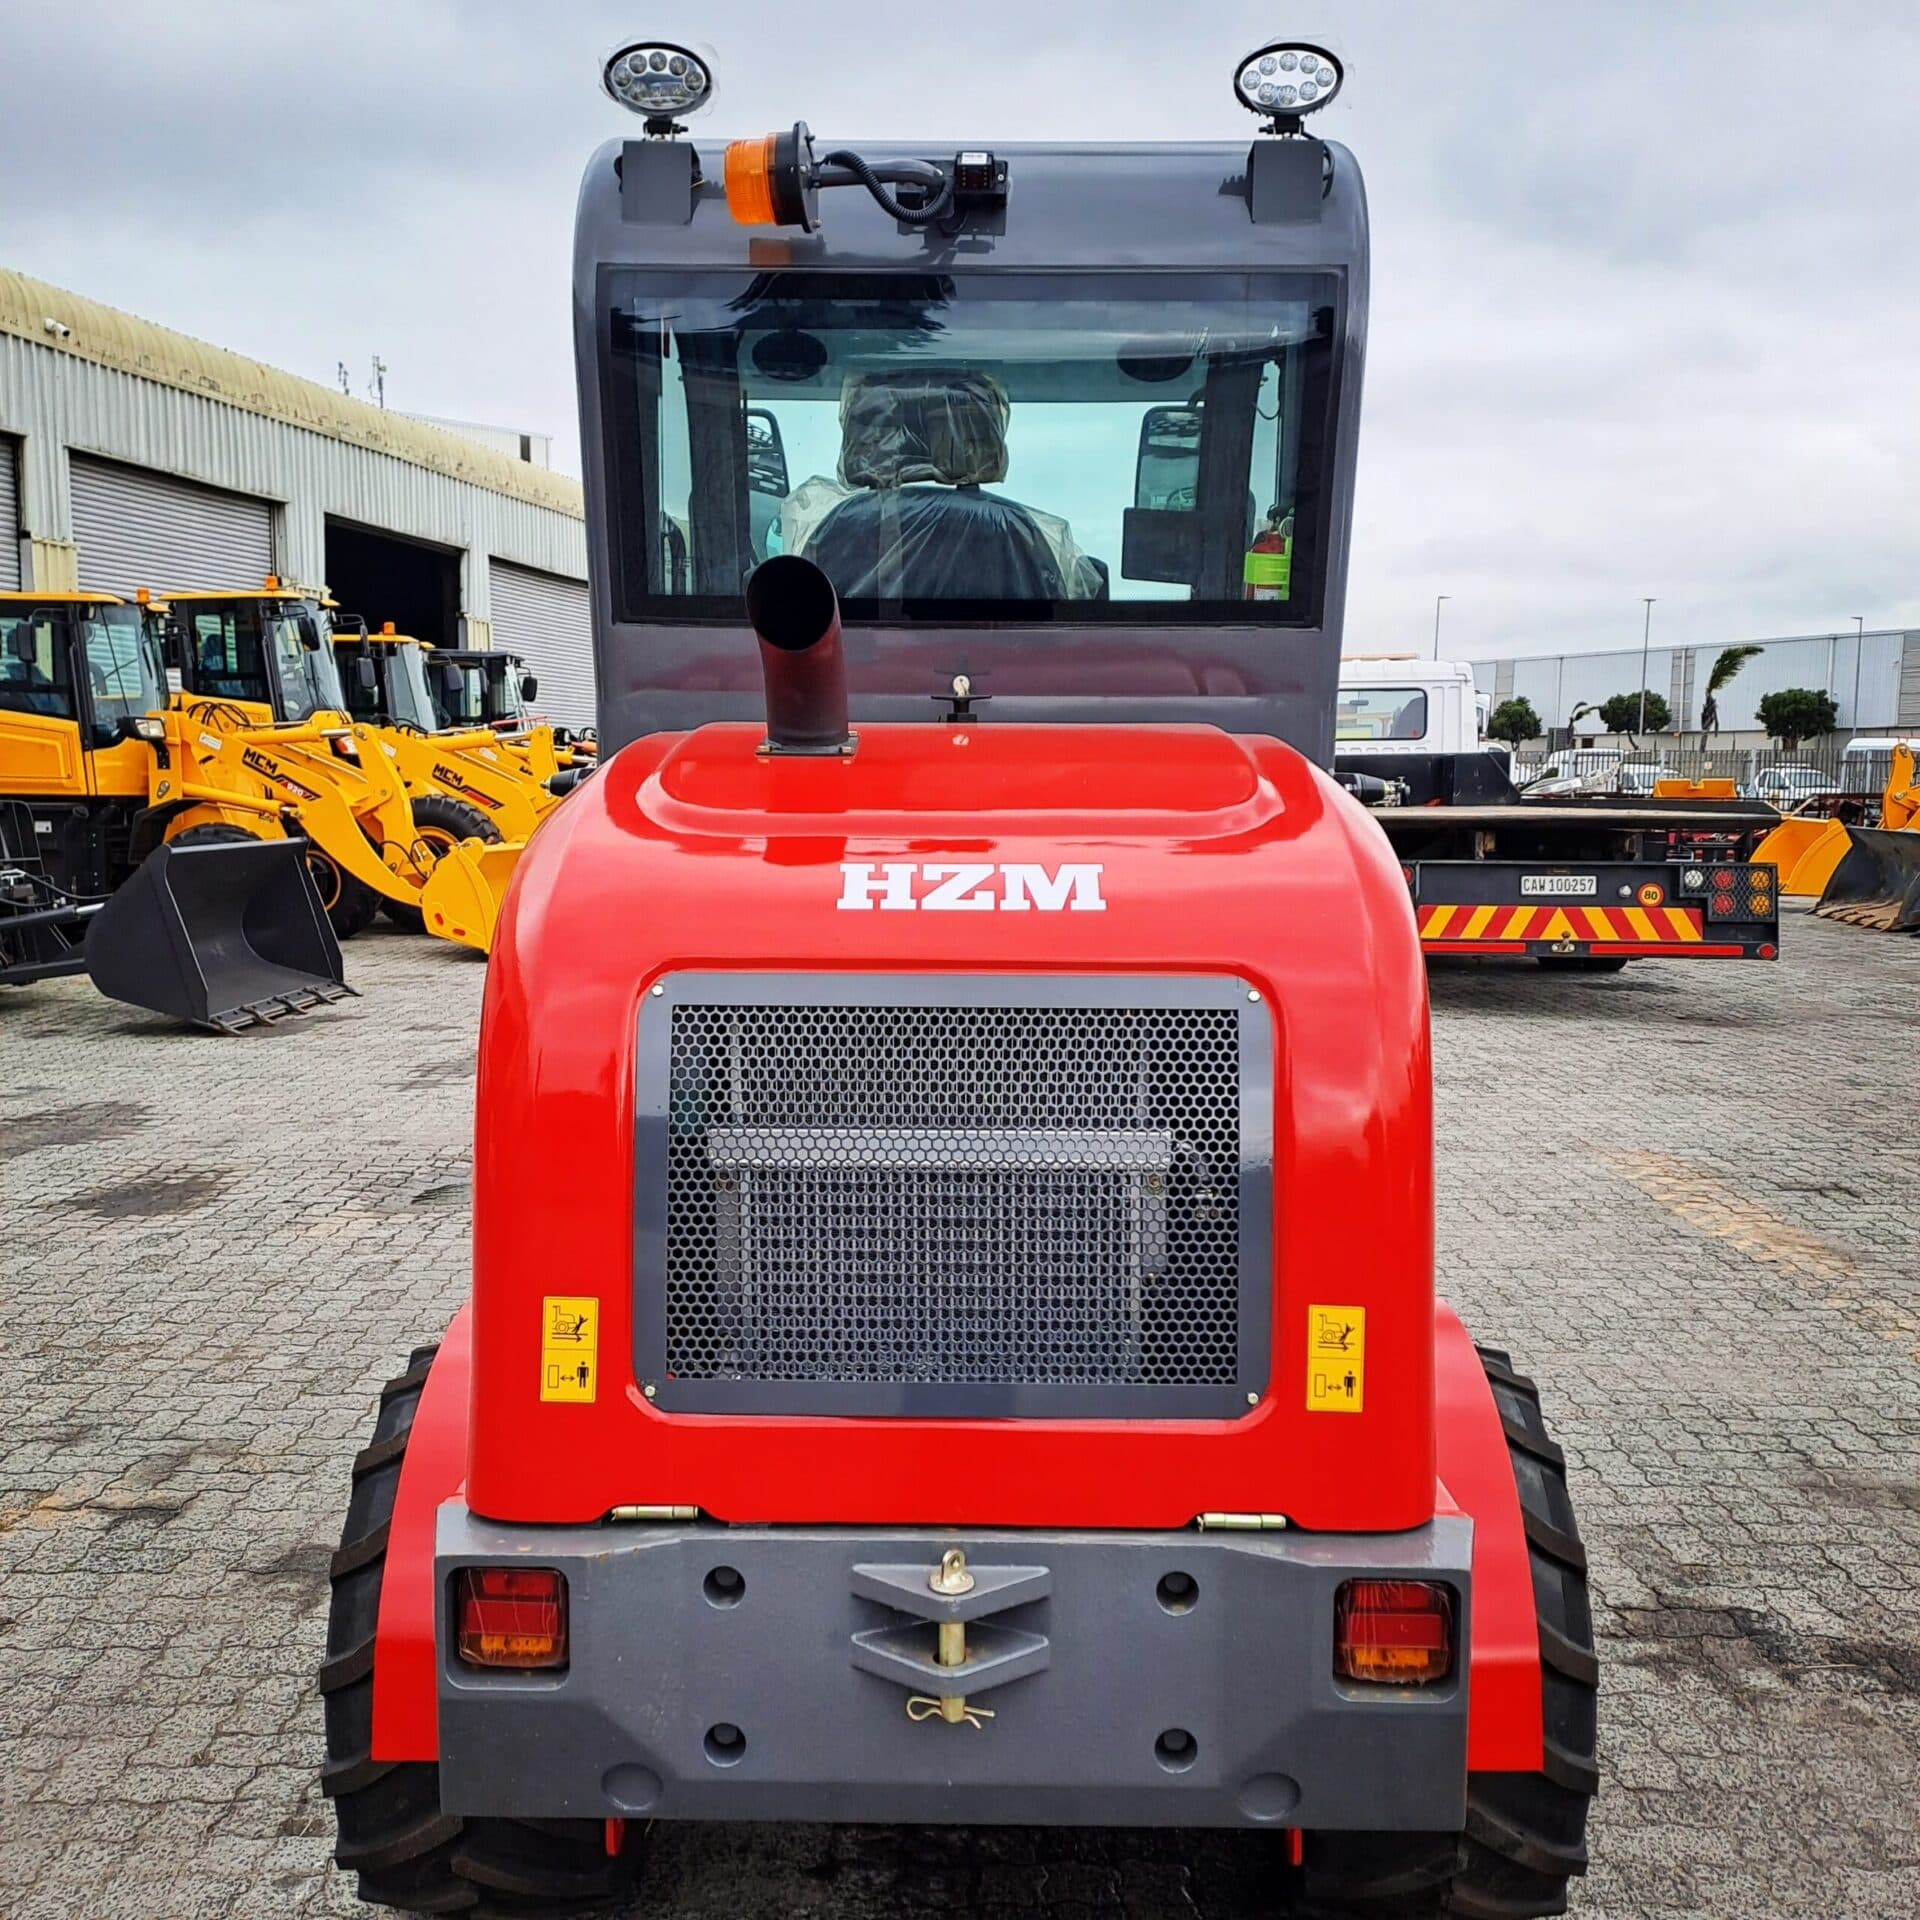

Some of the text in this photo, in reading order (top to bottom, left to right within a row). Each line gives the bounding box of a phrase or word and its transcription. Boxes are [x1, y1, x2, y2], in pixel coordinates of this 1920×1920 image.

[242, 747, 278, 774] MCM
[433, 763, 464, 785] MCM
[837, 863, 1107, 911] HZM
[1523, 878, 1546, 892] CAW
[1643, 890, 1658, 900] 80
